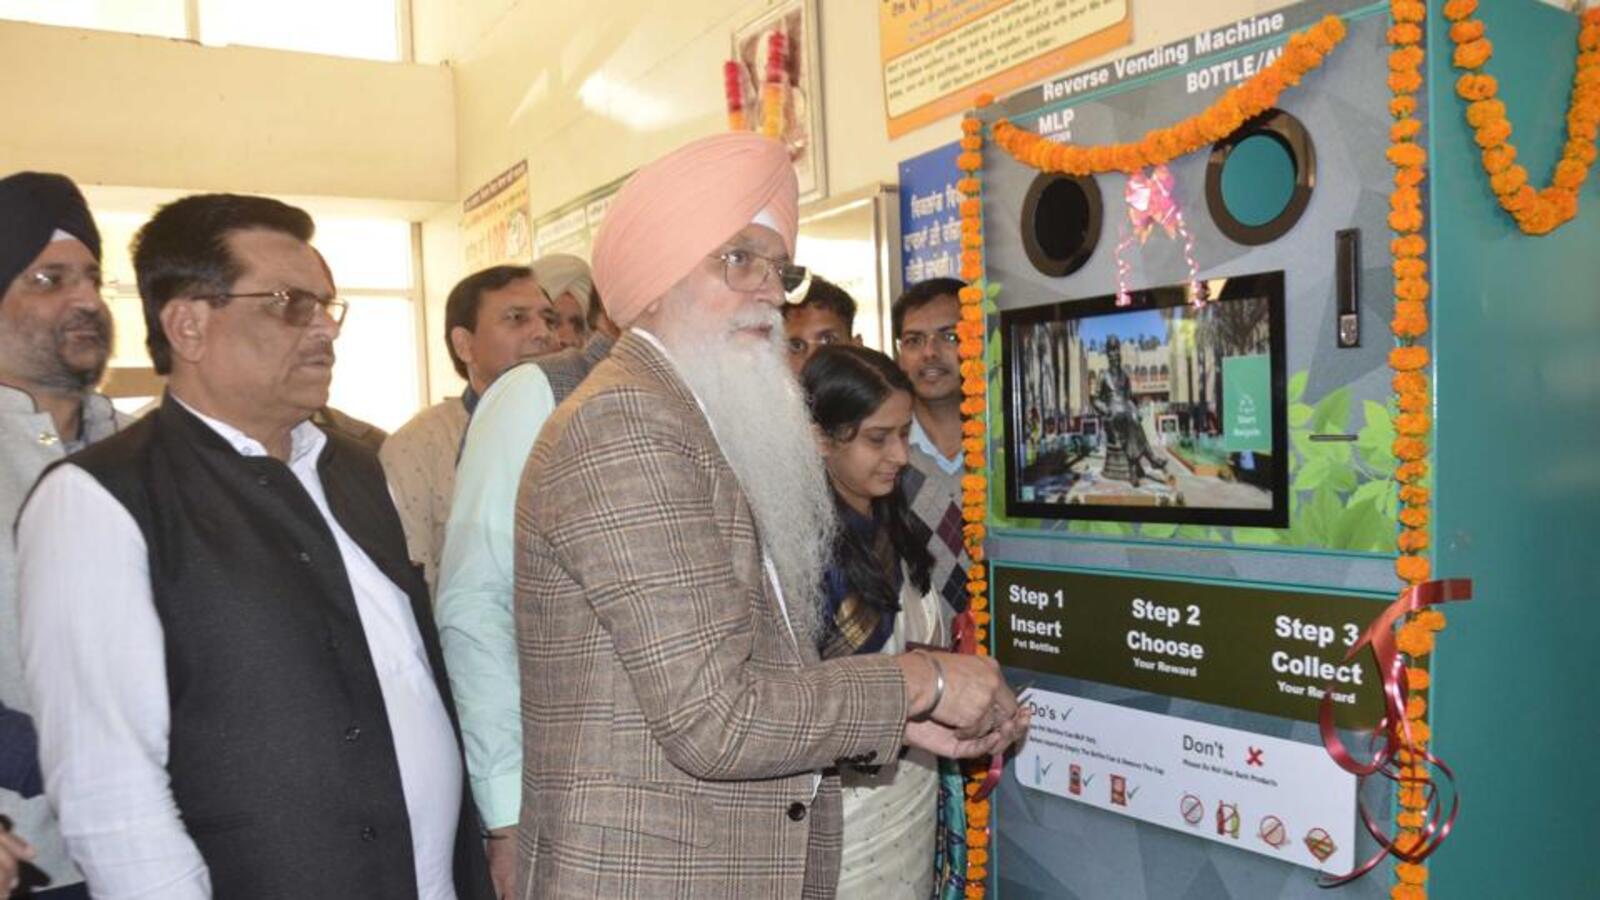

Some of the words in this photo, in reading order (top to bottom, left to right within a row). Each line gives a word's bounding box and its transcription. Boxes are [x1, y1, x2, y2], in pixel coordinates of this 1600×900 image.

[1043, 68, 1109, 102] Reverse
[1114, 43, 1188, 79] Vending
[1195, 13, 1284, 55] Machine
[1039, 108, 1075, 134] MLP
[1009, 584, 1049, 610] Step
[1054, 589, 1064, 608] 1
[1010, 613, 1062, 638] Insert
[1132, 598, 1180, 627] Step
[1186, 604, 1201, 626] 2
[1275, 615, 1335, 648] Step
[1342, 622, 1359, 647] 3
[1013, 638, 1027, 649] Pet
[1029, 640, 1060, 655] Bottles
[1126, 630, 1204, 660] Choose
[1132, 657, 1155, 669] Your
[1157, 661, 1197, 677] Reward
[1271, 651, 1363, 685] Collect
[1277, 681, 1305, 695] Your
[1029, 701, 1056, 720] Do's
[1183, 734, 1224, 760] Don't
